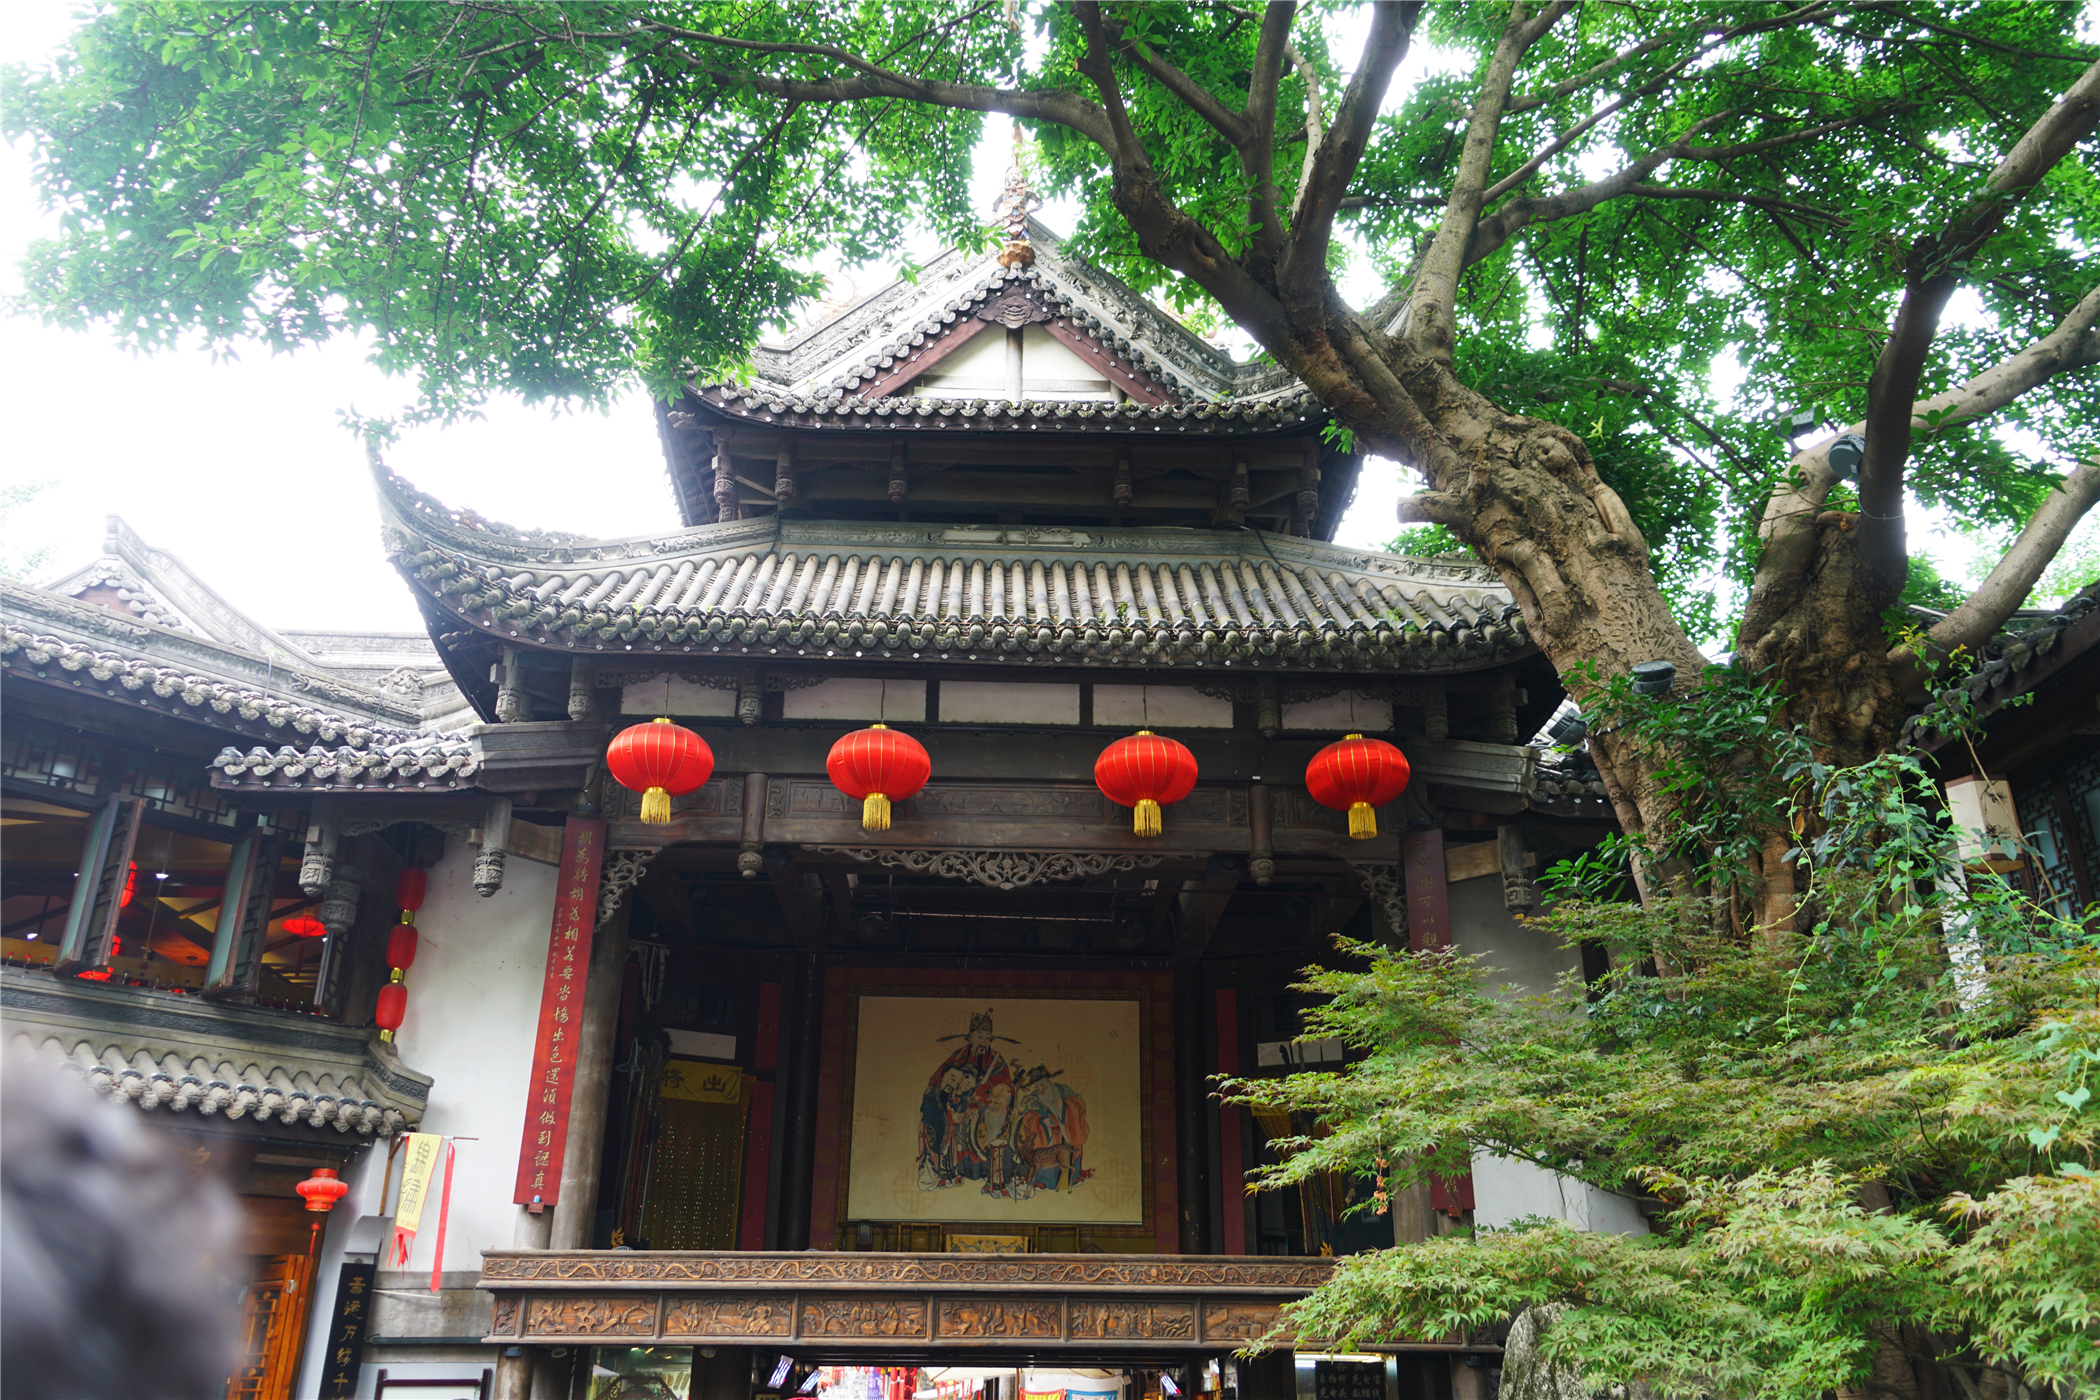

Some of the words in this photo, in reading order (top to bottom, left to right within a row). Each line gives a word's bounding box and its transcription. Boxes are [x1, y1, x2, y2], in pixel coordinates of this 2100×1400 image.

[1319, 1373, 1347, 1384] 自拍杆
[1352, 1373, 1382, 1385] 充电宝
[1319, 1387, 1347, 1399] 充电头
[1352, 1387, 1382, 1399] 数据线
